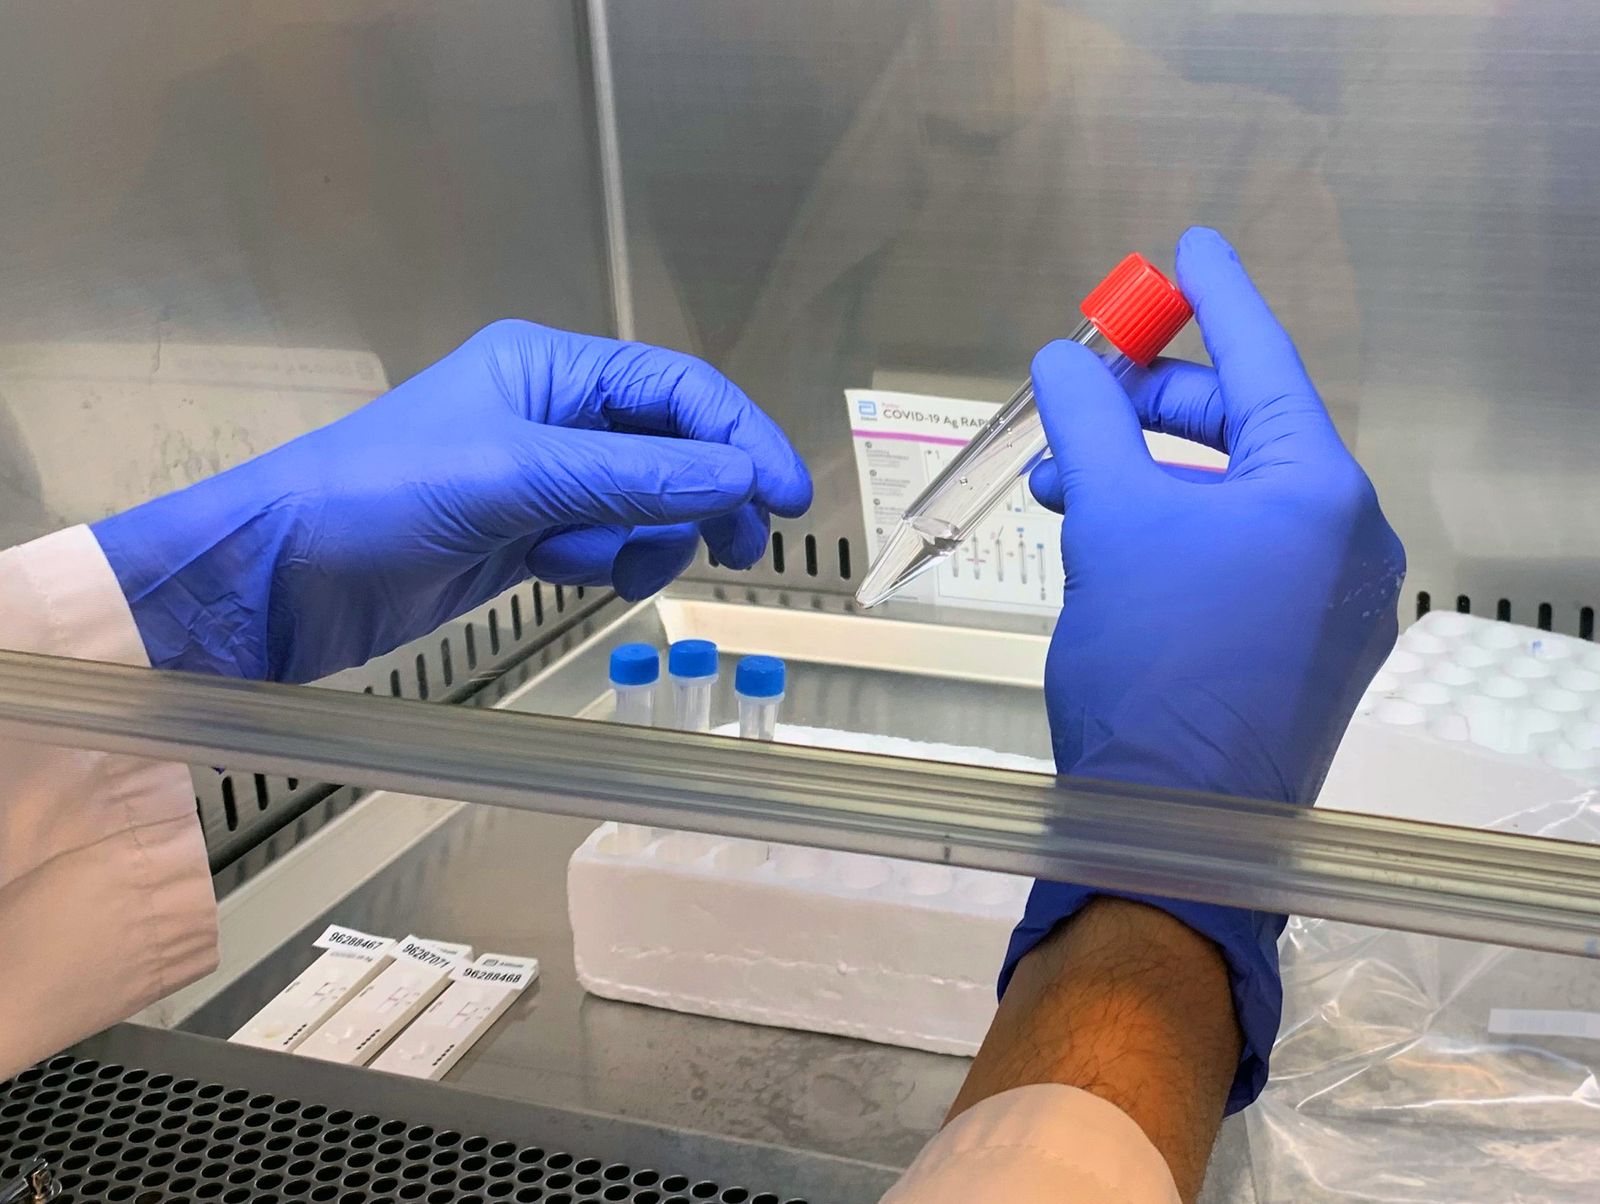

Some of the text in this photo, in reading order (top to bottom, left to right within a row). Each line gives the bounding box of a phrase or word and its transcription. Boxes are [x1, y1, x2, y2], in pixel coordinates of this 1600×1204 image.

[883, 409, 940, 422] COVID-19
[944, 416, 959, 427] Ag
[328, 932, 384, 950] 96288467
[402, 943, 451, 969] 96287071
[463, 968, 523, 984] 96288468
